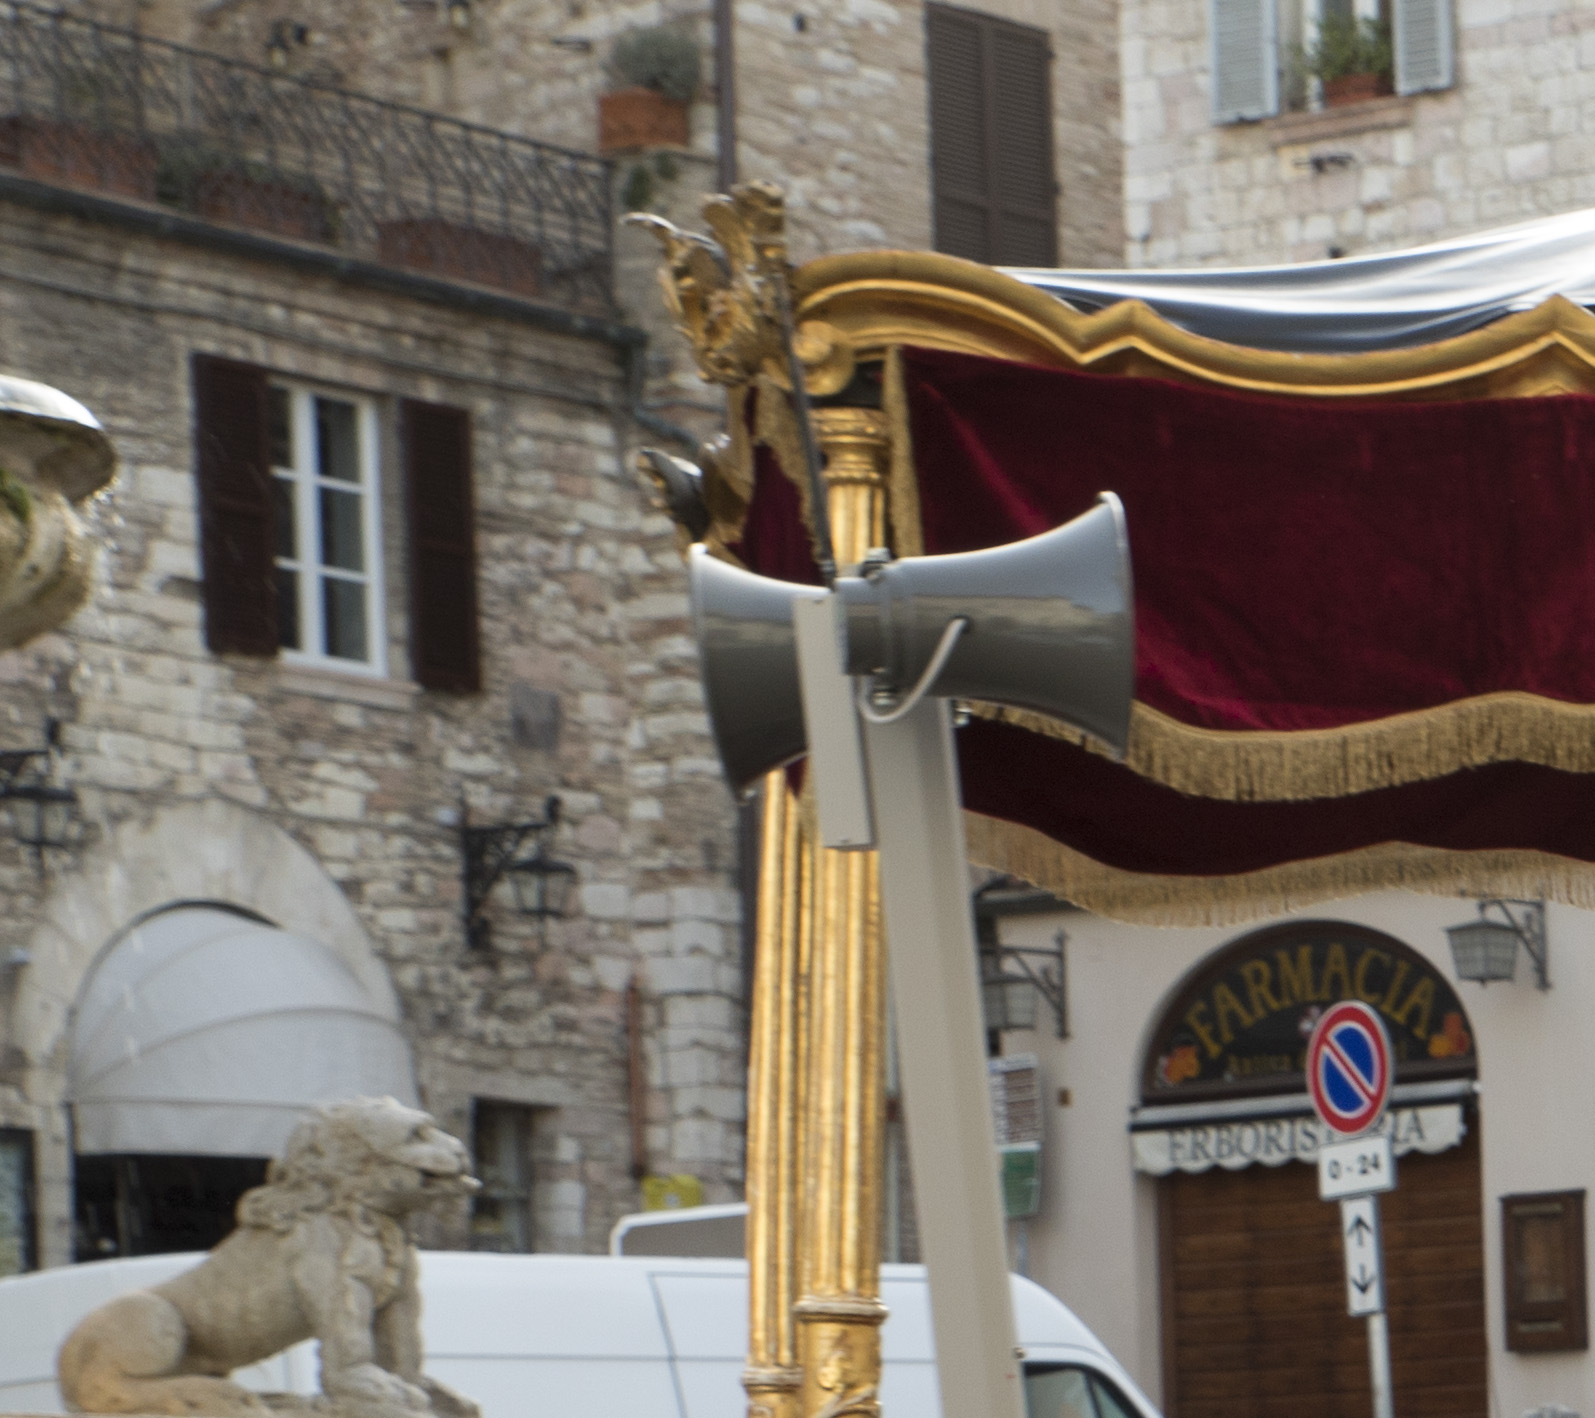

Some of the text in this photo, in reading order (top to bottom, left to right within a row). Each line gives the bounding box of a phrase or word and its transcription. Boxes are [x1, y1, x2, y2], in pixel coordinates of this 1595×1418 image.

[1185, 944, 1436, 1059] FARMACIA
[1328, 1159, 1339, 1179] 0
[1358, 1153, 1380, 1175] 24
